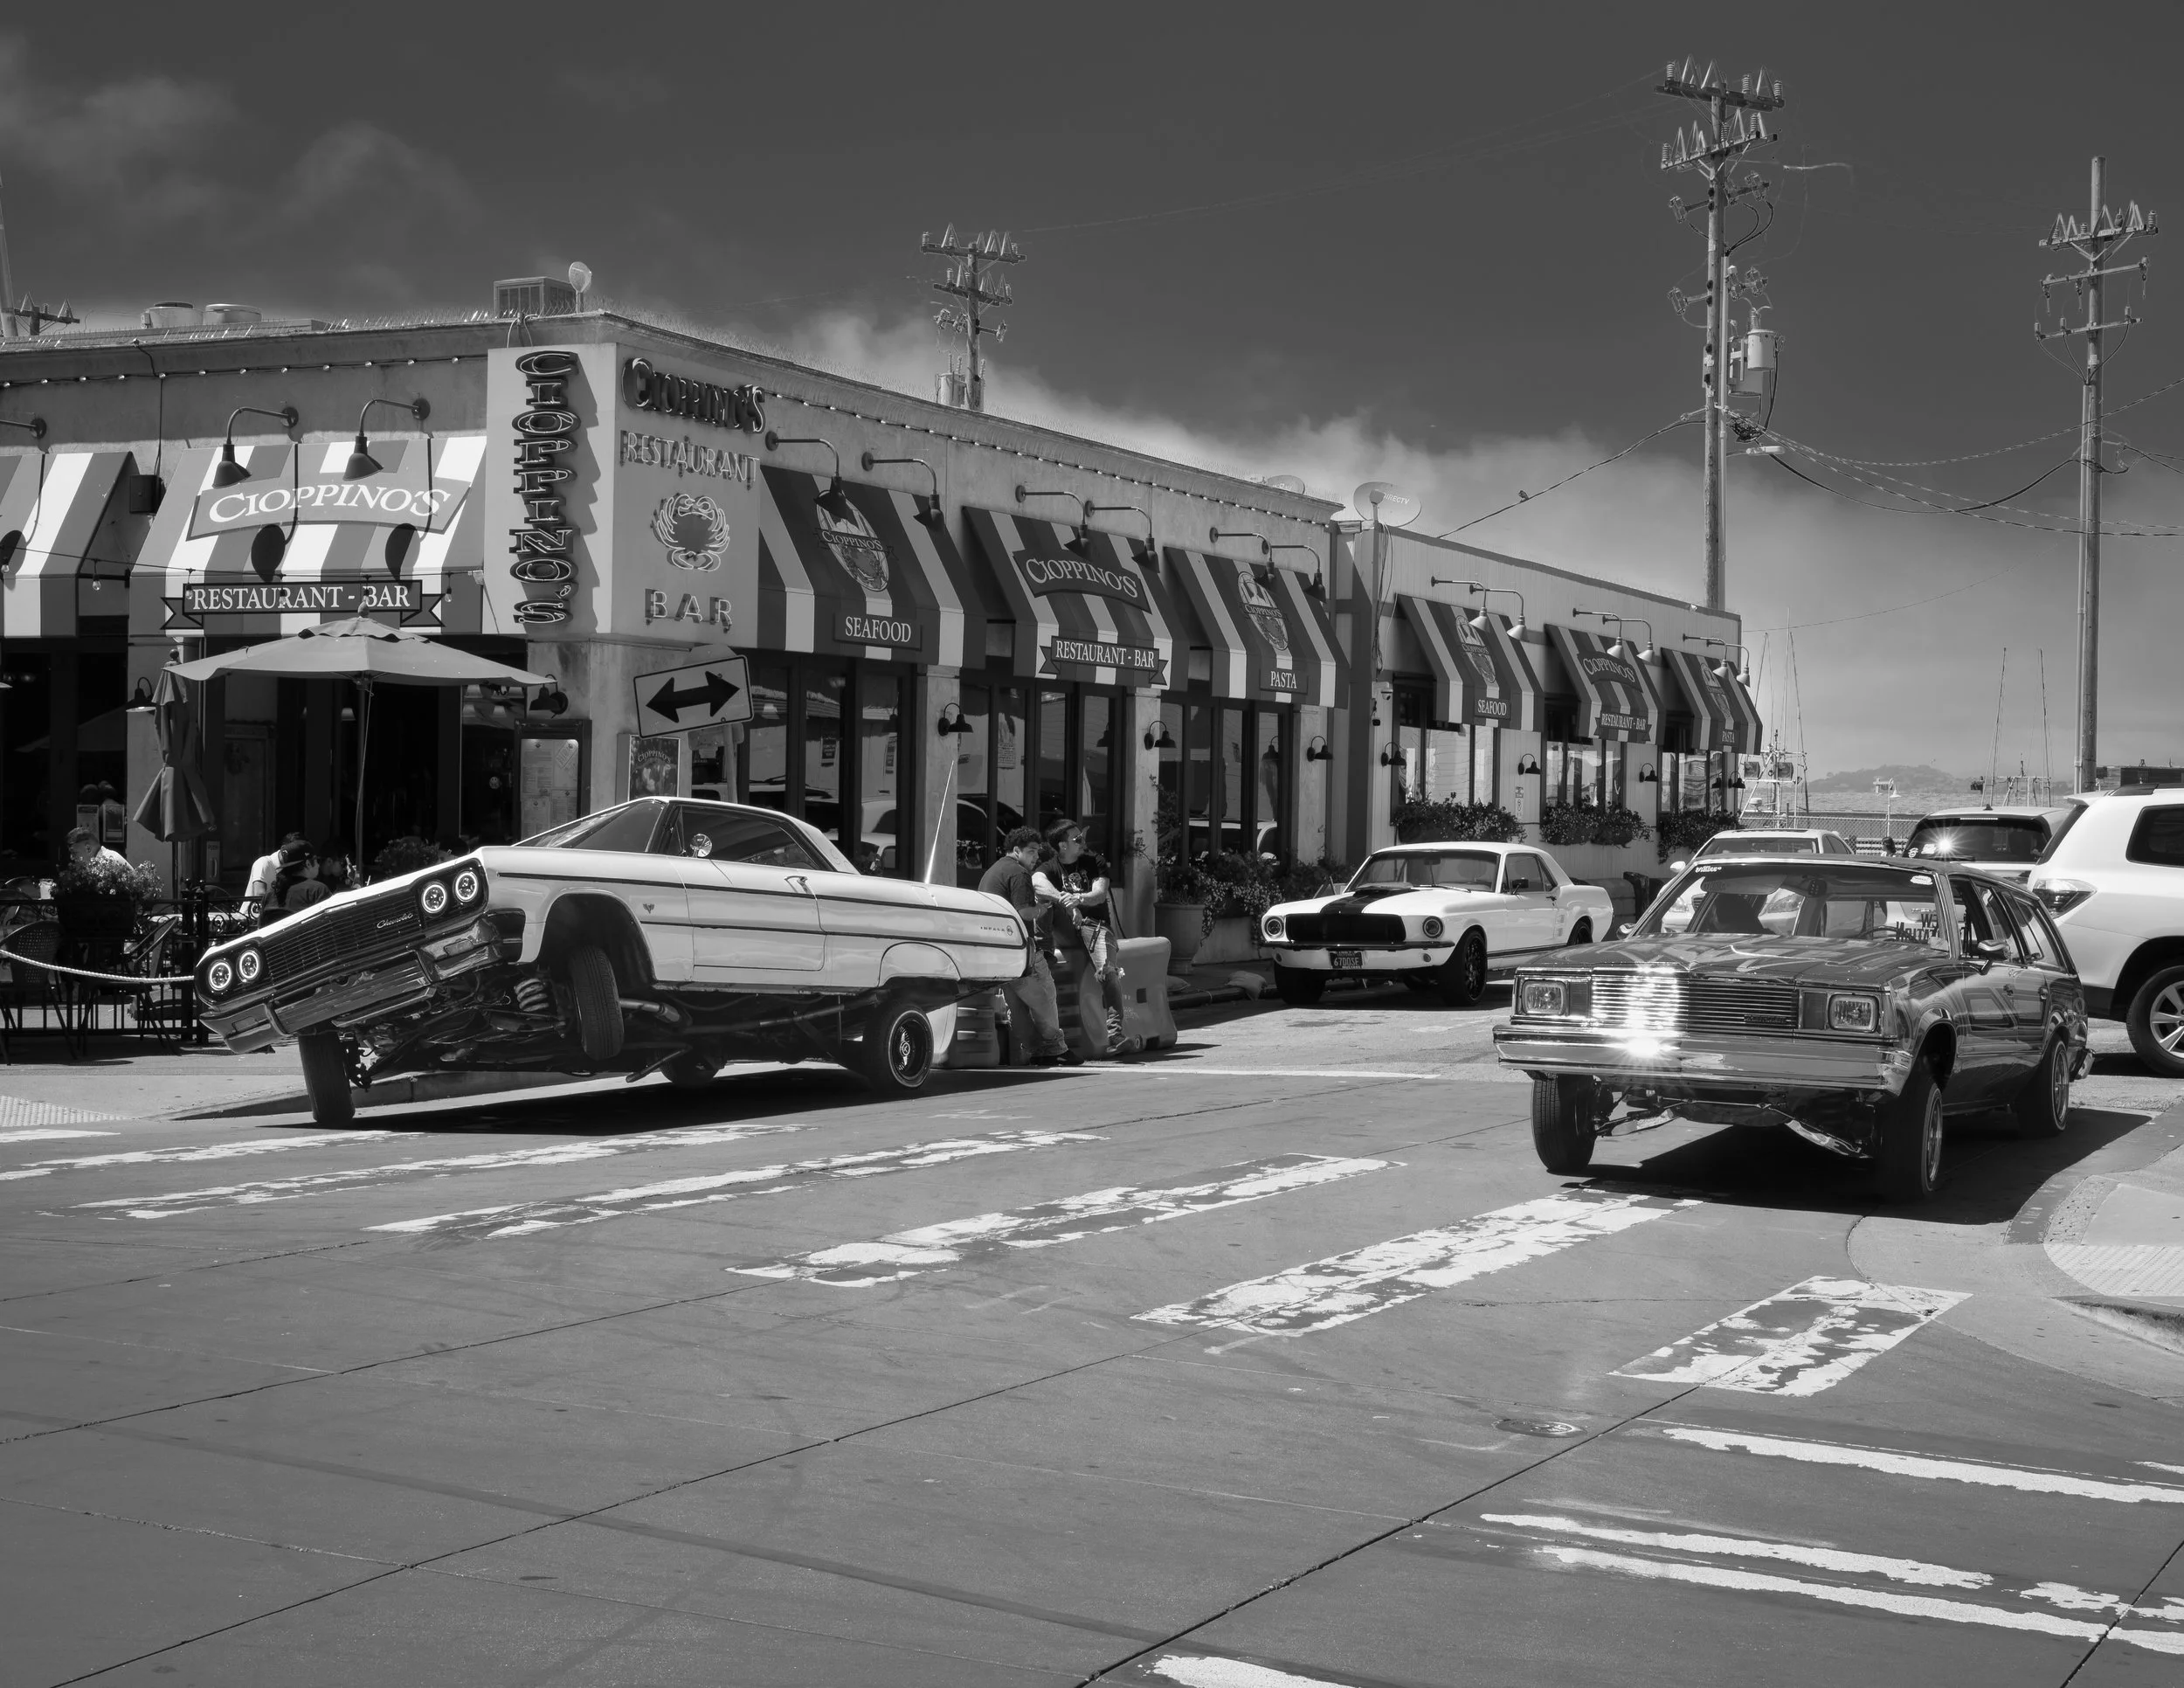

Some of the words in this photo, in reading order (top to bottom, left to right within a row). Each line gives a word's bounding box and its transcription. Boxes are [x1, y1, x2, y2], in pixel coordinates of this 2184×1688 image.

[621, 357, 766, 433] CIOPPINO'S
[624, 431, 760, 482] RESTAURANT
[509, 350, 581, 624] CIOPPINO'S
[209, 483, 451, 522] CIOPPINO'S
[821, 530, 883, 550] CIOPPINO'S
[1026, 558, 1138, 598] CIOPPINO'S
[193, 586, 342, 610] RESTAURANT
[363, 585, 411, 607] BAR
[647, 589, 732, 626] BAR
[845, 616, 911, 642] SEAFOOD
[1055, 640, 1126, 665] RESTAURANT
[1134, 649, 1155, 668] BAR
[1270, 670, 1297, 688] PASTA
[1583, 658, 1635, 682] CIOPPINO'S
[1477, 699, 1507, 716] SEAFOOD
[1600, 713, 1633, 729] RESTAURANT
[1635, 717, 1647, 730] BAR
[638, 749, 672, 763] CIOPPINO'S
